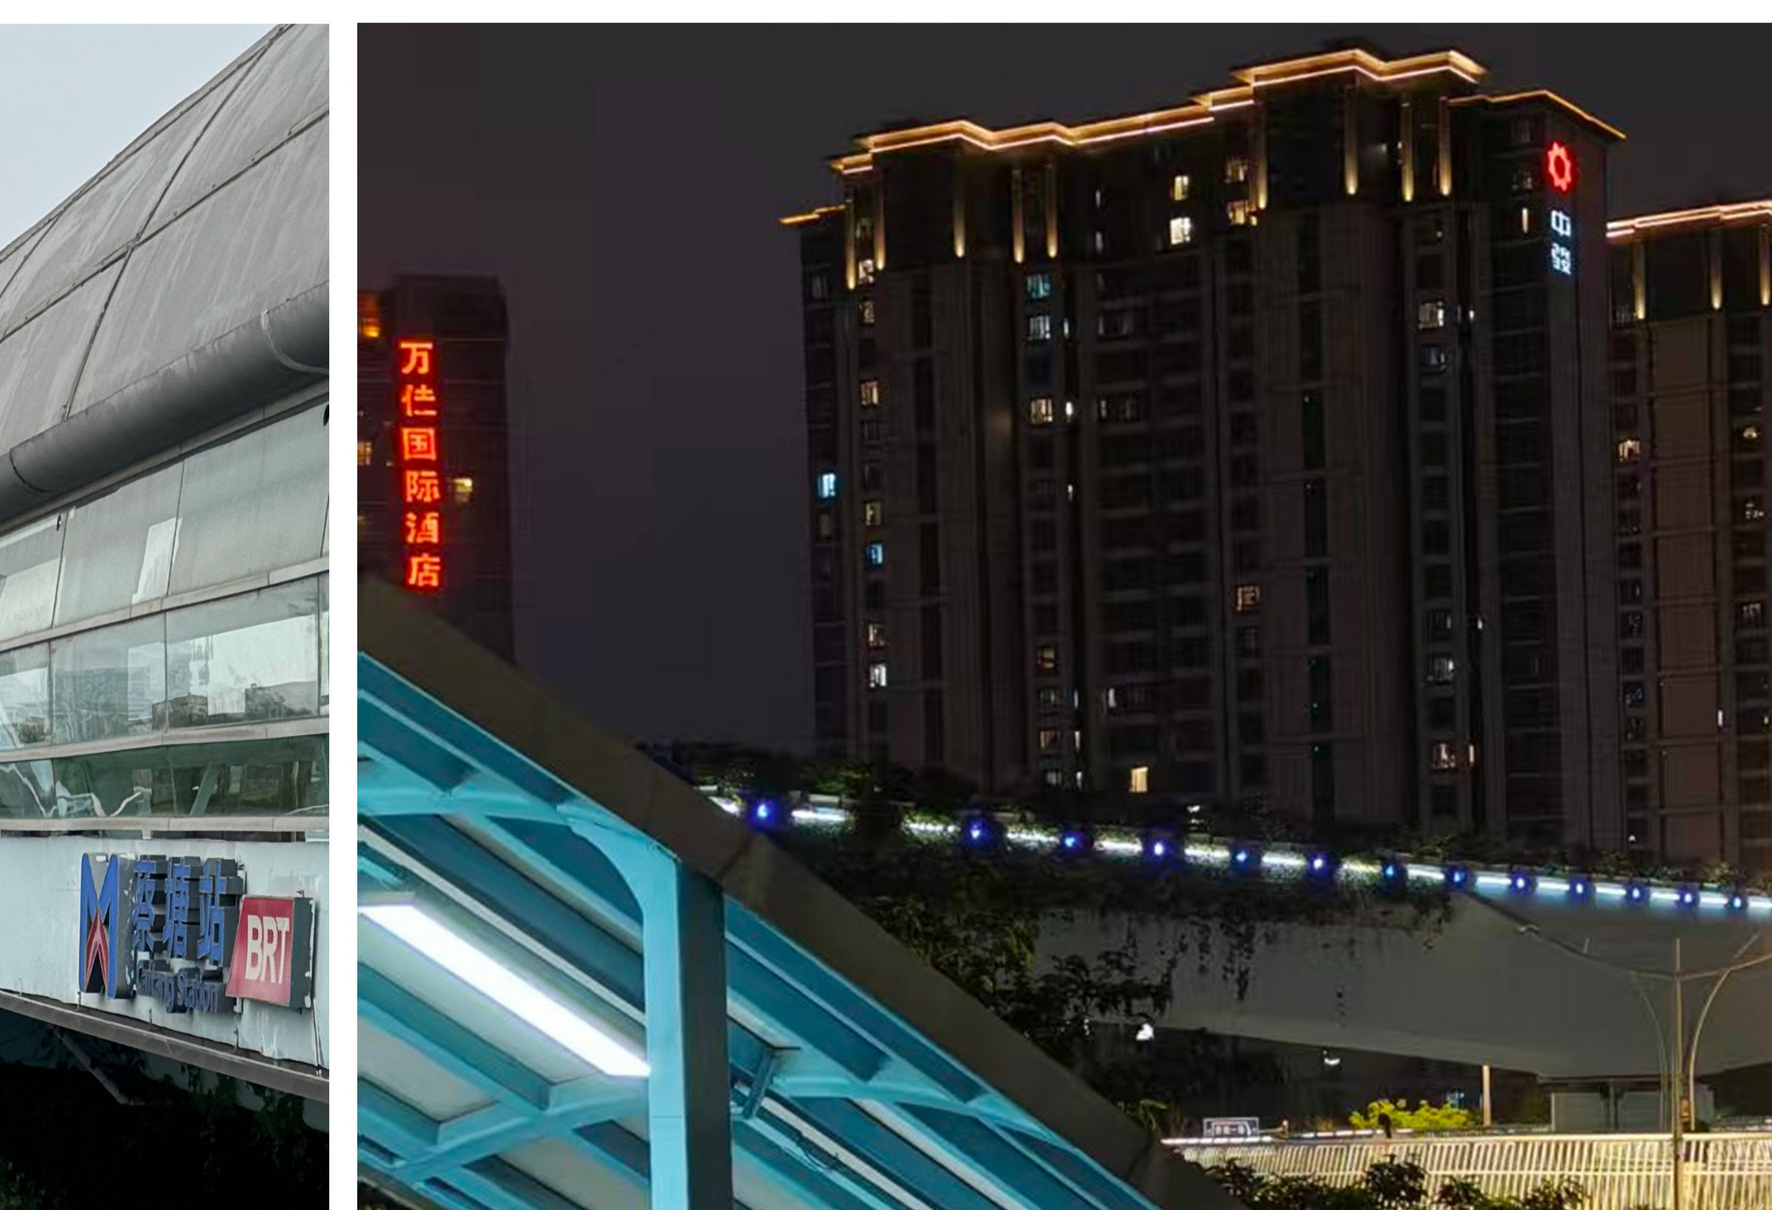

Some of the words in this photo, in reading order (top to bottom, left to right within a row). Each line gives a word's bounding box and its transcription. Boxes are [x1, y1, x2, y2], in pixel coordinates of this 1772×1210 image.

[134, 859, 227, 967] 蔡塘站
[244, 914, 290, 985] BRT
[177, 968, 218, 1014] Station
